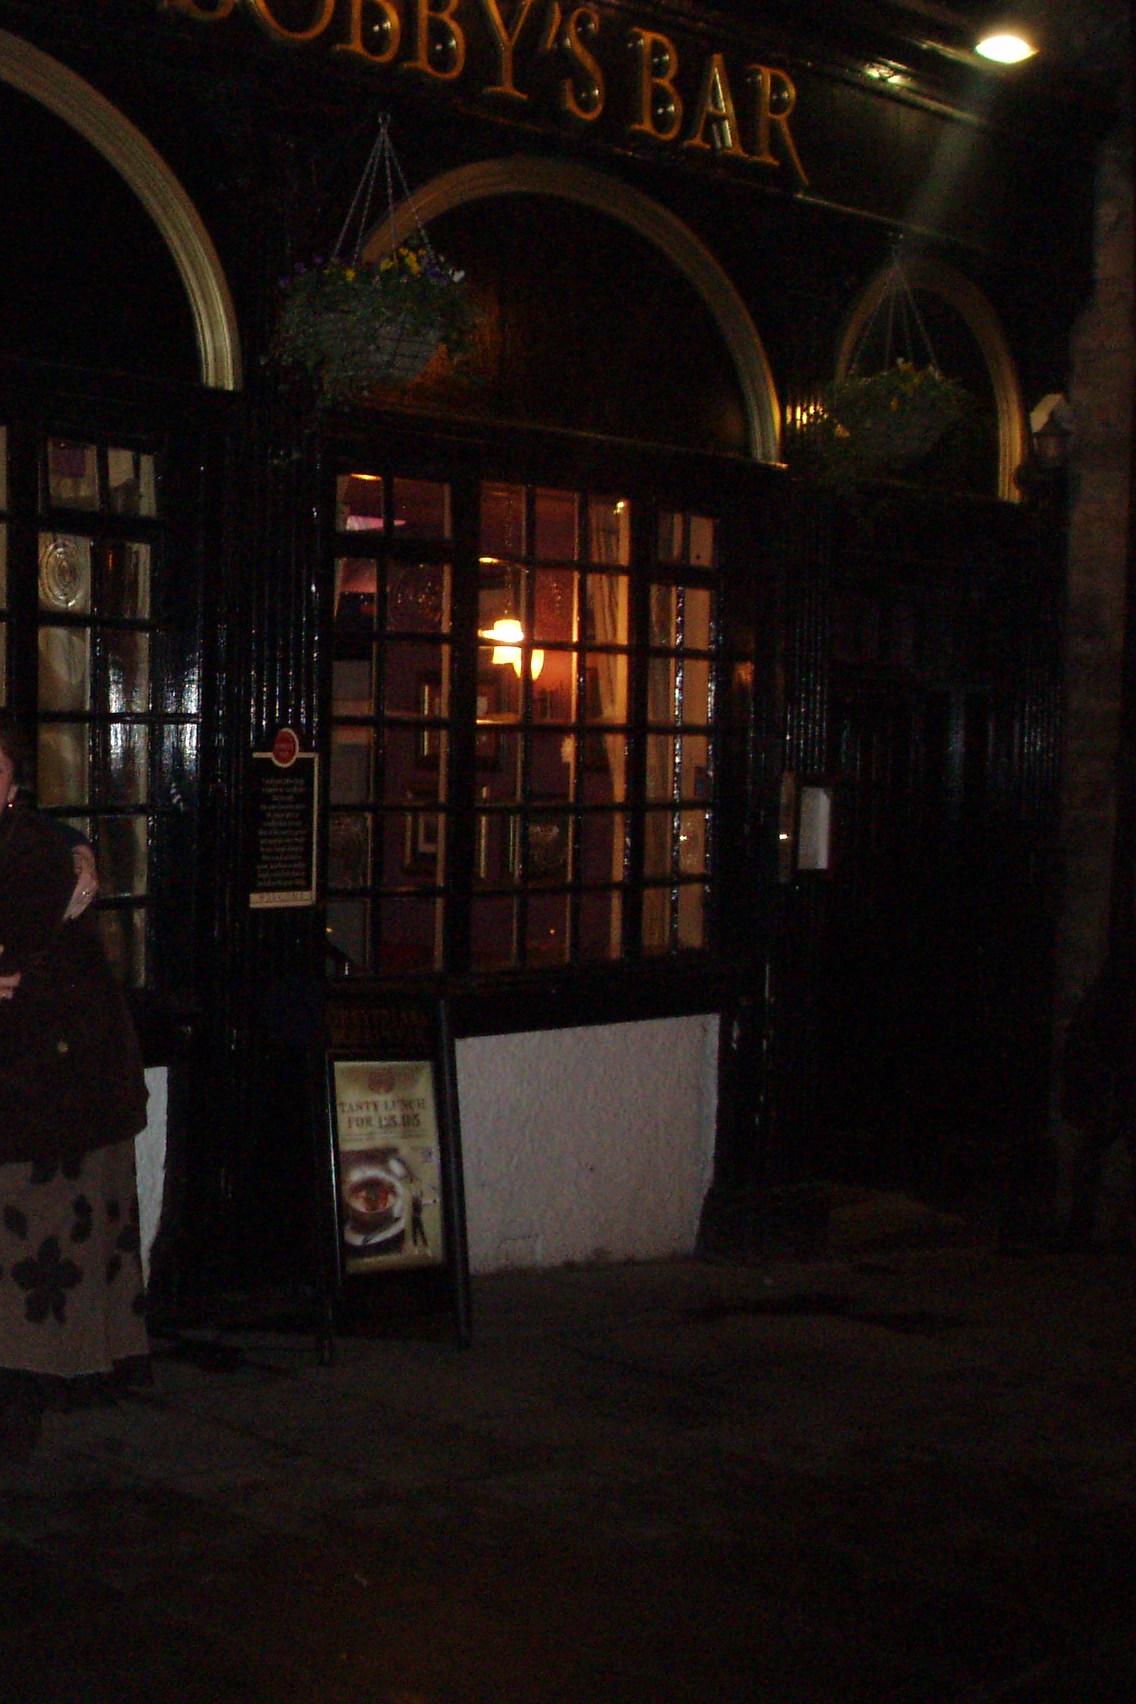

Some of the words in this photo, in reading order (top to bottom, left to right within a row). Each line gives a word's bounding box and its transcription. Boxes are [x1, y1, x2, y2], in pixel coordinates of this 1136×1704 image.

[160, 0, 606, 122] BBY'S
[627, 26, 810, 187] BAR
[338, 1100, 378, 1114] TASTY
[383, 1097, 425, 1112] LUNCH
[347, 1115, 374, 1129] FOR
